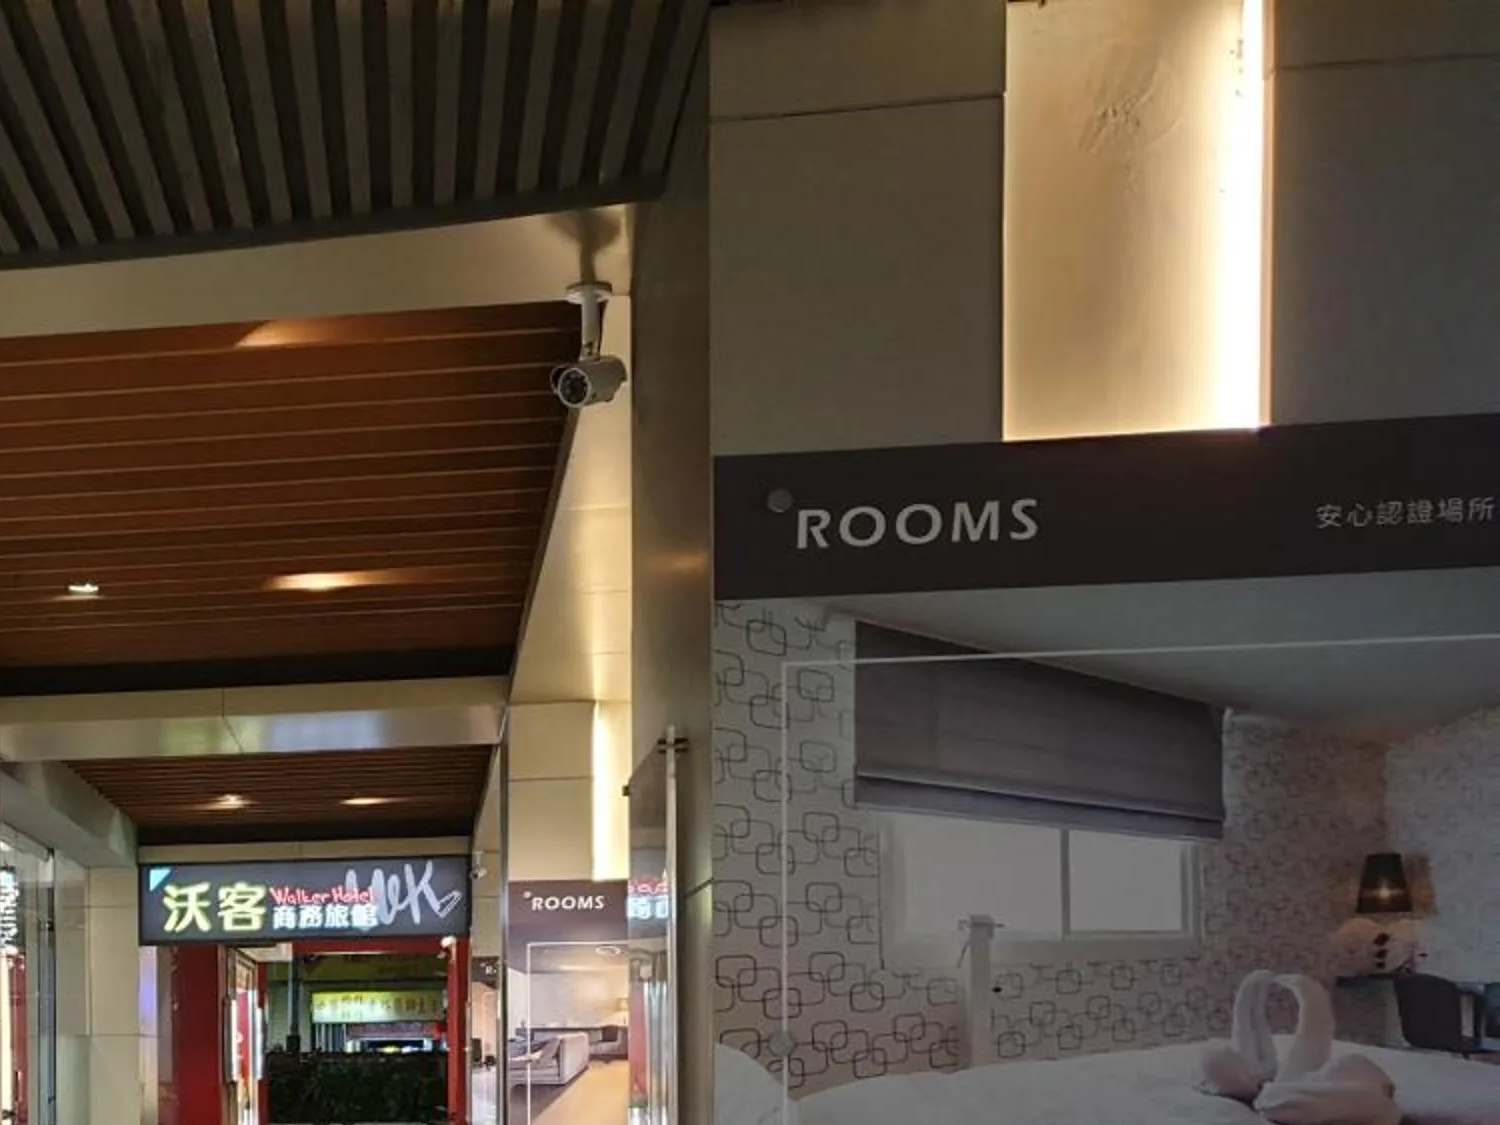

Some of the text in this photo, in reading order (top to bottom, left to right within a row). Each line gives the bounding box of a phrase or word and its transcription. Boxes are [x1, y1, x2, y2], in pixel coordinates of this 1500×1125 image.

[797, 498, 1040, 549] ROOMS
[1315, 496, 1495, 529] 安心認證場所
[162, 881, 267, 934] 沃客
[269, 884, 374, 904] Walker Hotel
[531, 894, 605, 911] ROOMS
